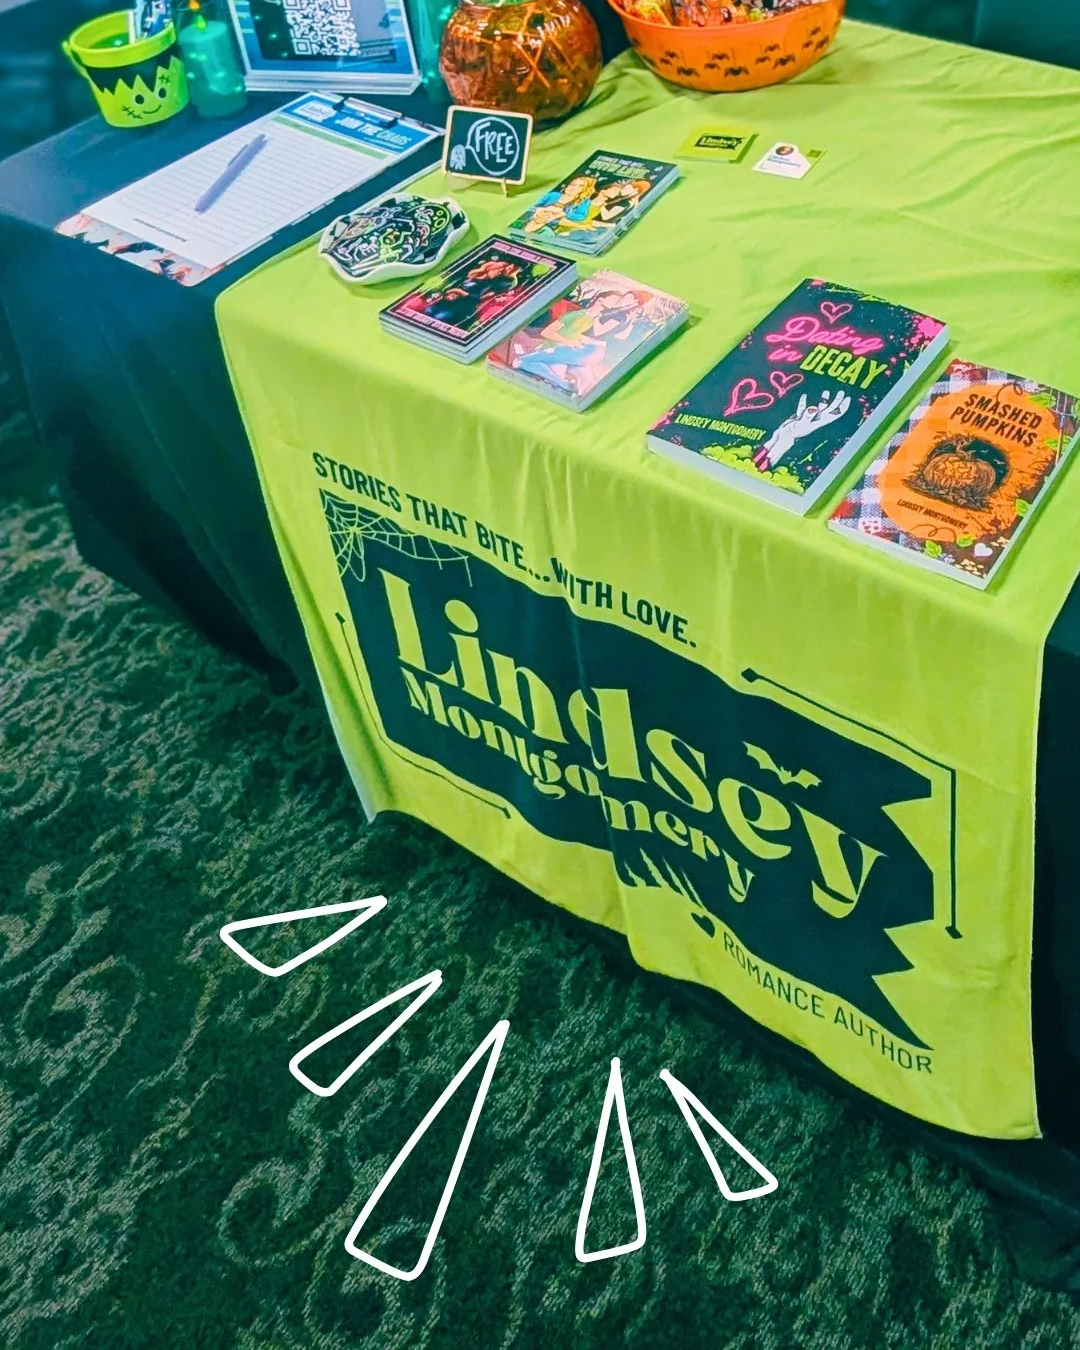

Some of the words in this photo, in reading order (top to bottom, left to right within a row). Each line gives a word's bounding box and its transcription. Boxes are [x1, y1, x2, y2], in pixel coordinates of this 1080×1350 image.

[357, 123, 384, 136] THE
[475, 121, 514, 163] FREE
[700, 136, 739, 147] Lindsey
[765, 314, 888, 352] Dating
[769, 344, 804, 365] in
[800, 344, 889, 390] DECAY
[674, 413, 710, 430] LINDSEY
[710, 418, 767, 442] MONTGOMERY
[949, 405, 1040, 448] PUMPKINS
[963, 392, 1043, 430] SMASHED
[896, 497, 924, 513] LINDSEY
[922, 505, 968, 531] MONTGOMERY
[311, 453, 404, 515] STORIES
[404, 494, 468, 539] THAT
[619, 590, 700, 649] LOVE.
[377, 566, 889, 920] Lindsey
[398, 665, 758, 903] Montgomery
[722, 930, 828, 1021] ROMANCE
[831, 1005, 934, 1076] AUTHOR
